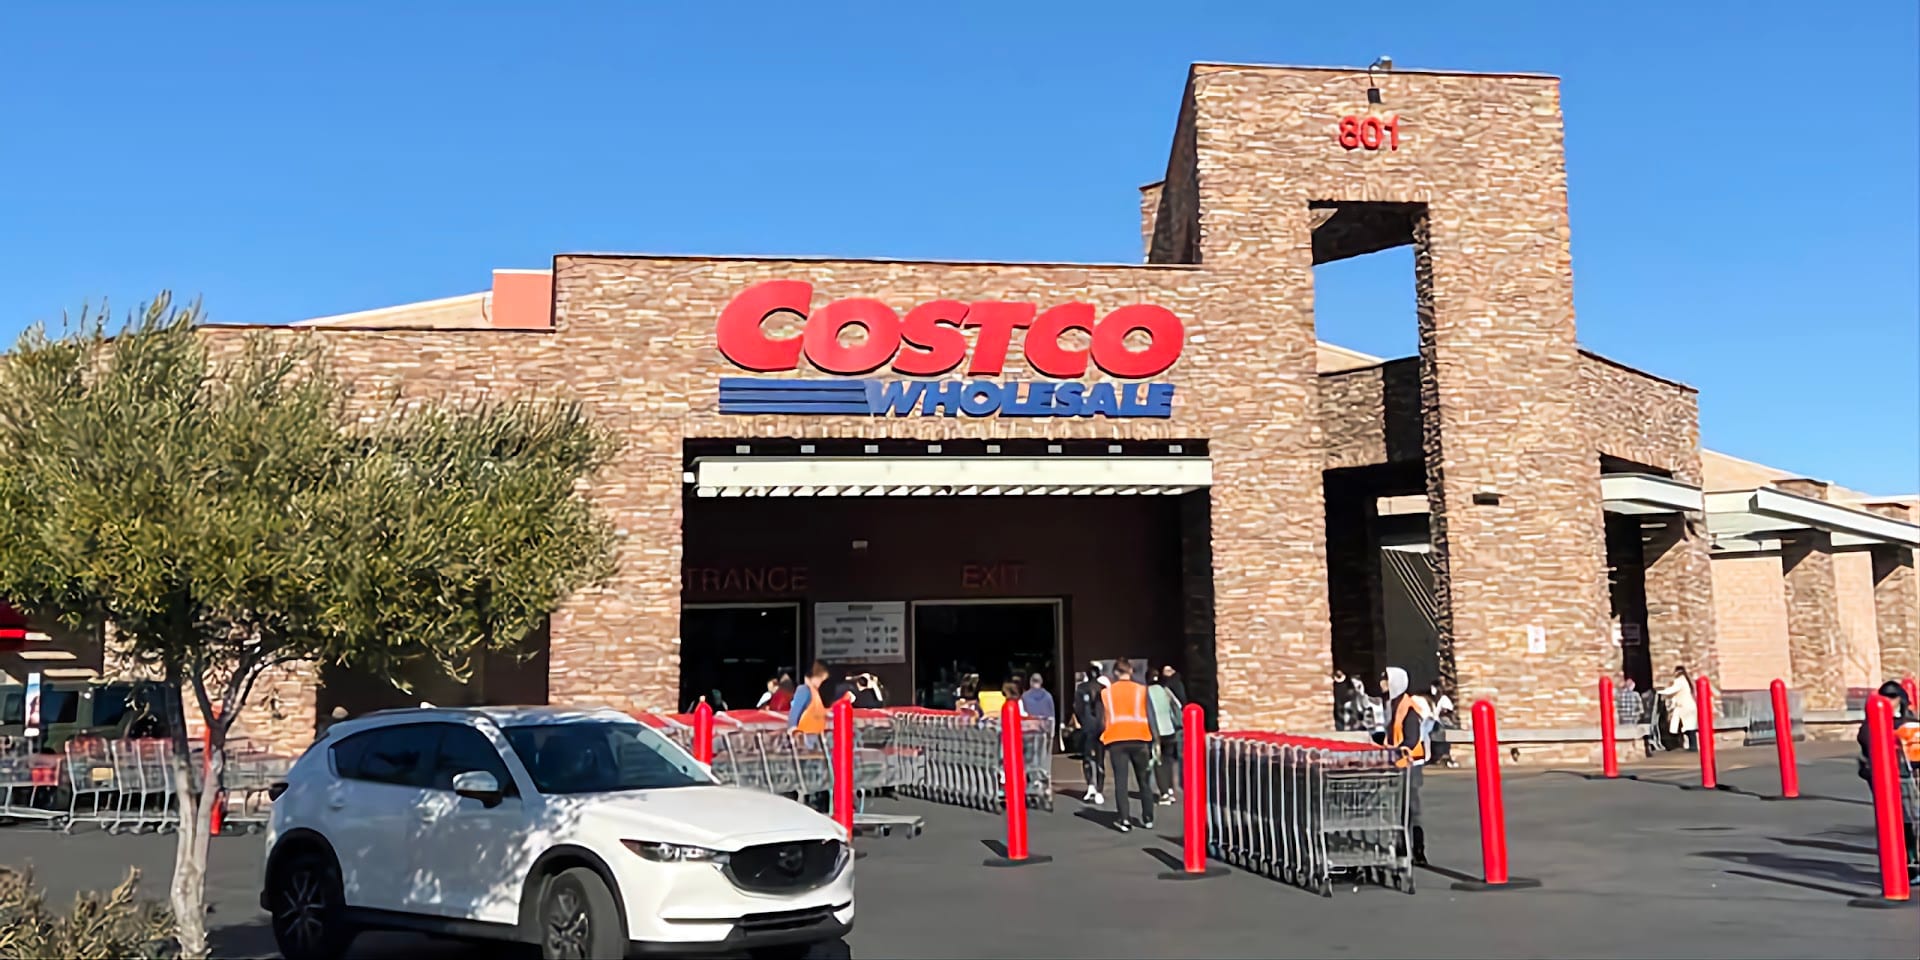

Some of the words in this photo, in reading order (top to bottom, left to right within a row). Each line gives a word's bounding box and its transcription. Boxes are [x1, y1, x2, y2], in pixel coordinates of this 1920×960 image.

[1339, 115, 1399, 151] 801
[716, 280, 1185, 378] COSTCO
[867, 380, 1174, 418] WHOLESALE
[687, 566, 809, 592] TRANCE
[961, 563, 1024, 591] EXIT
